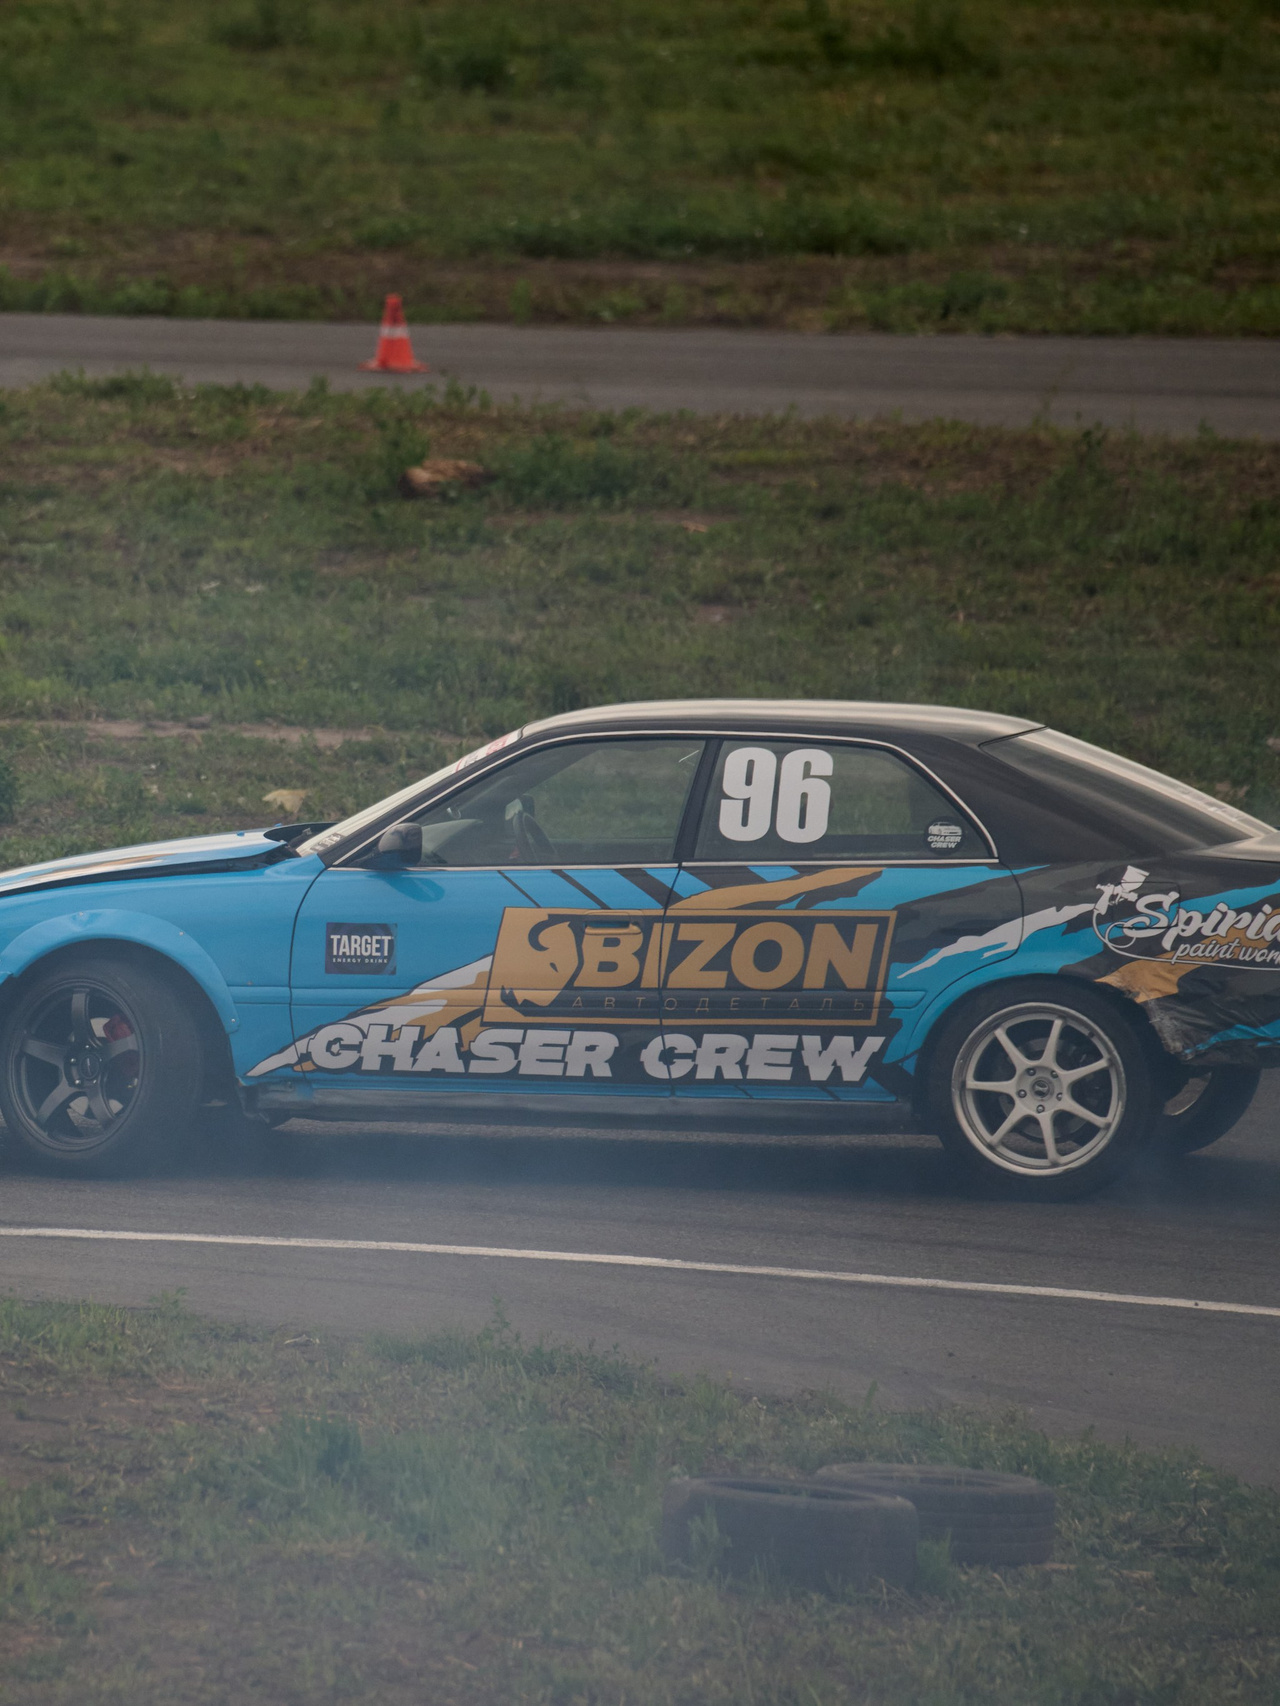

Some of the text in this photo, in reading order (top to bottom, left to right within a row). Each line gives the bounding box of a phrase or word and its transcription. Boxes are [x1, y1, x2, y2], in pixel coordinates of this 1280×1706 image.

[719, 747, 834, 843] 96
[927, 835, 962, 843] CHASER
[330, 934, 392, 957] TARGET
[573, 921, 879, 990] BIZON
[1171, 938, 1241, 965] paint
[572, 996, 866, 1013] АВТОДЕТАЛЬ
[307, 1022, 886, 1082] CHASER CREW
